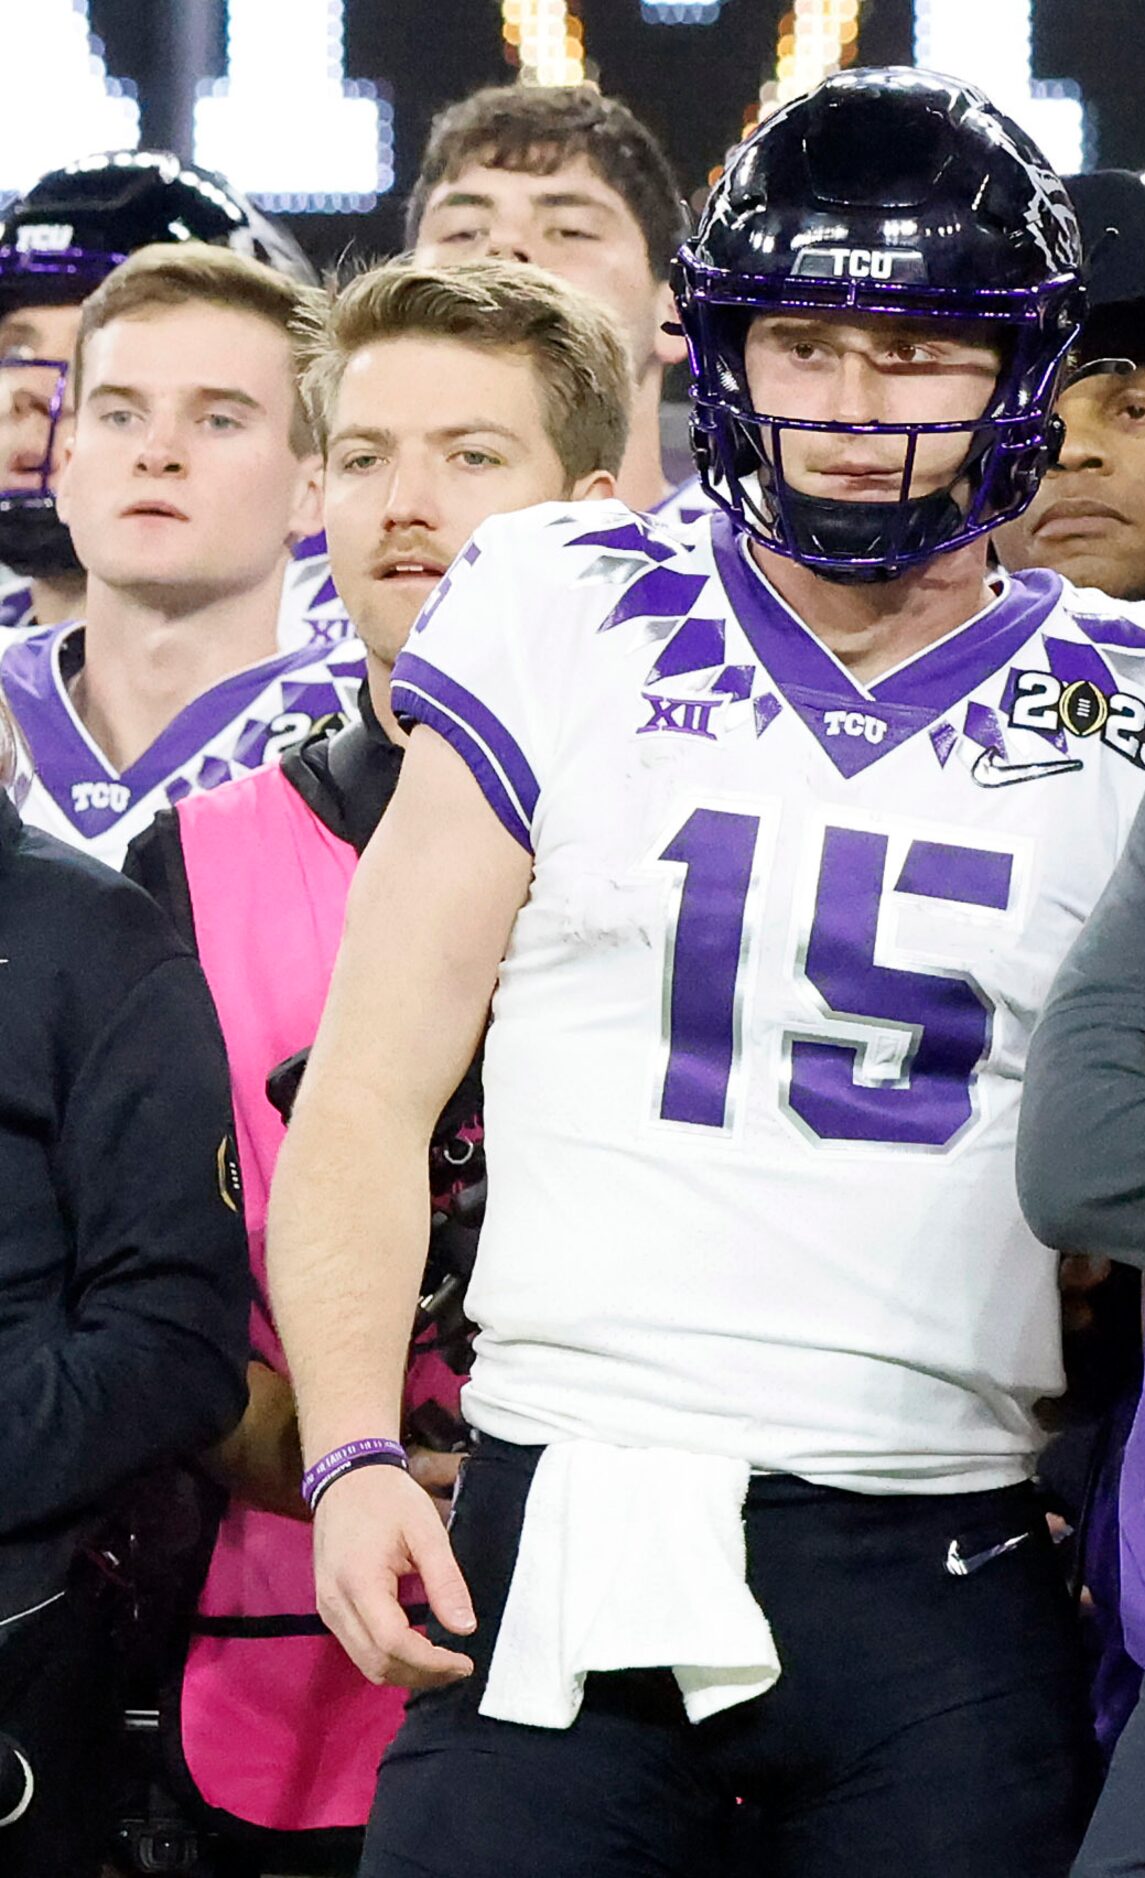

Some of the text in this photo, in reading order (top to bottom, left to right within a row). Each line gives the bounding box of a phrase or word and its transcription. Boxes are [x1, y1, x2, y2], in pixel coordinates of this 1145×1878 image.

[829, 247, 894, 280] TCU
[635, 691, 725, 741] XII
[822, 709, 888, 745] TCU
[71, 781, 133, 814] TCU
[650, 803, 1020, 1151] 15
